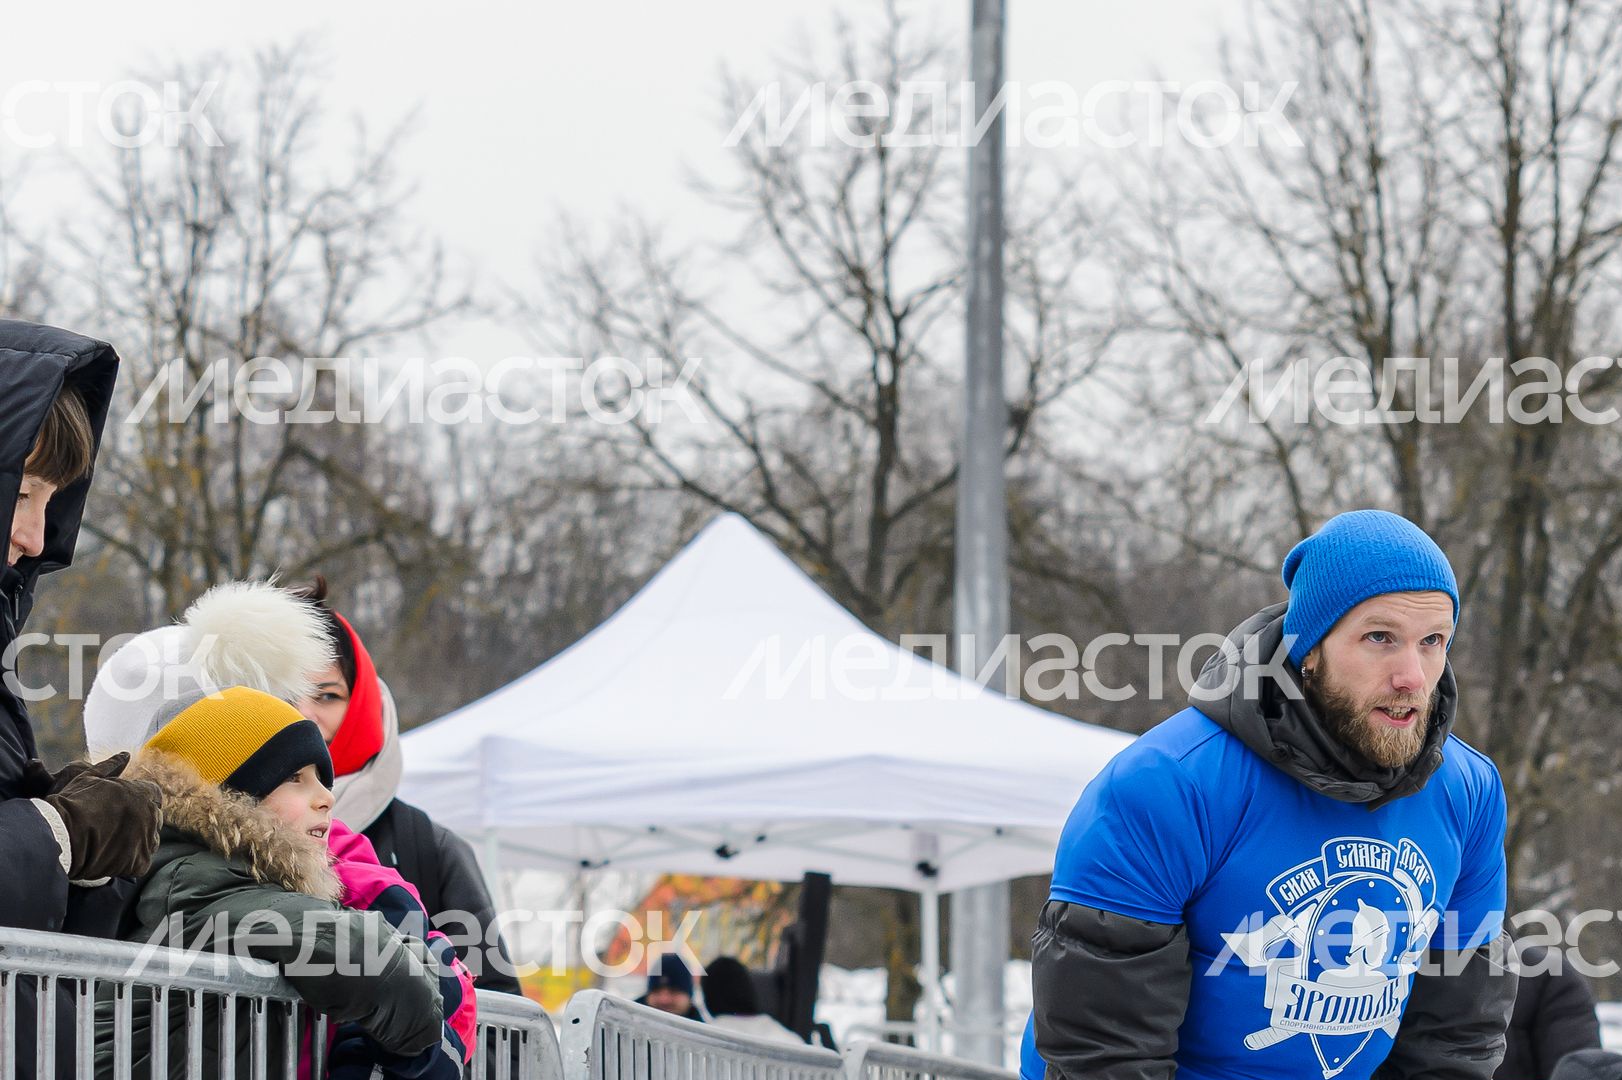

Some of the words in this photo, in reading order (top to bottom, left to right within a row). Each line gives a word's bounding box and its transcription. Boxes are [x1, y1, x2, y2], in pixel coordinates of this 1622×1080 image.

[1278, 867, 1322, 906] СИЛА
[1335, 843, 1392, 873] СЛАВА
[1283, 979, 1399, 1024] ЯРОПОЛК
